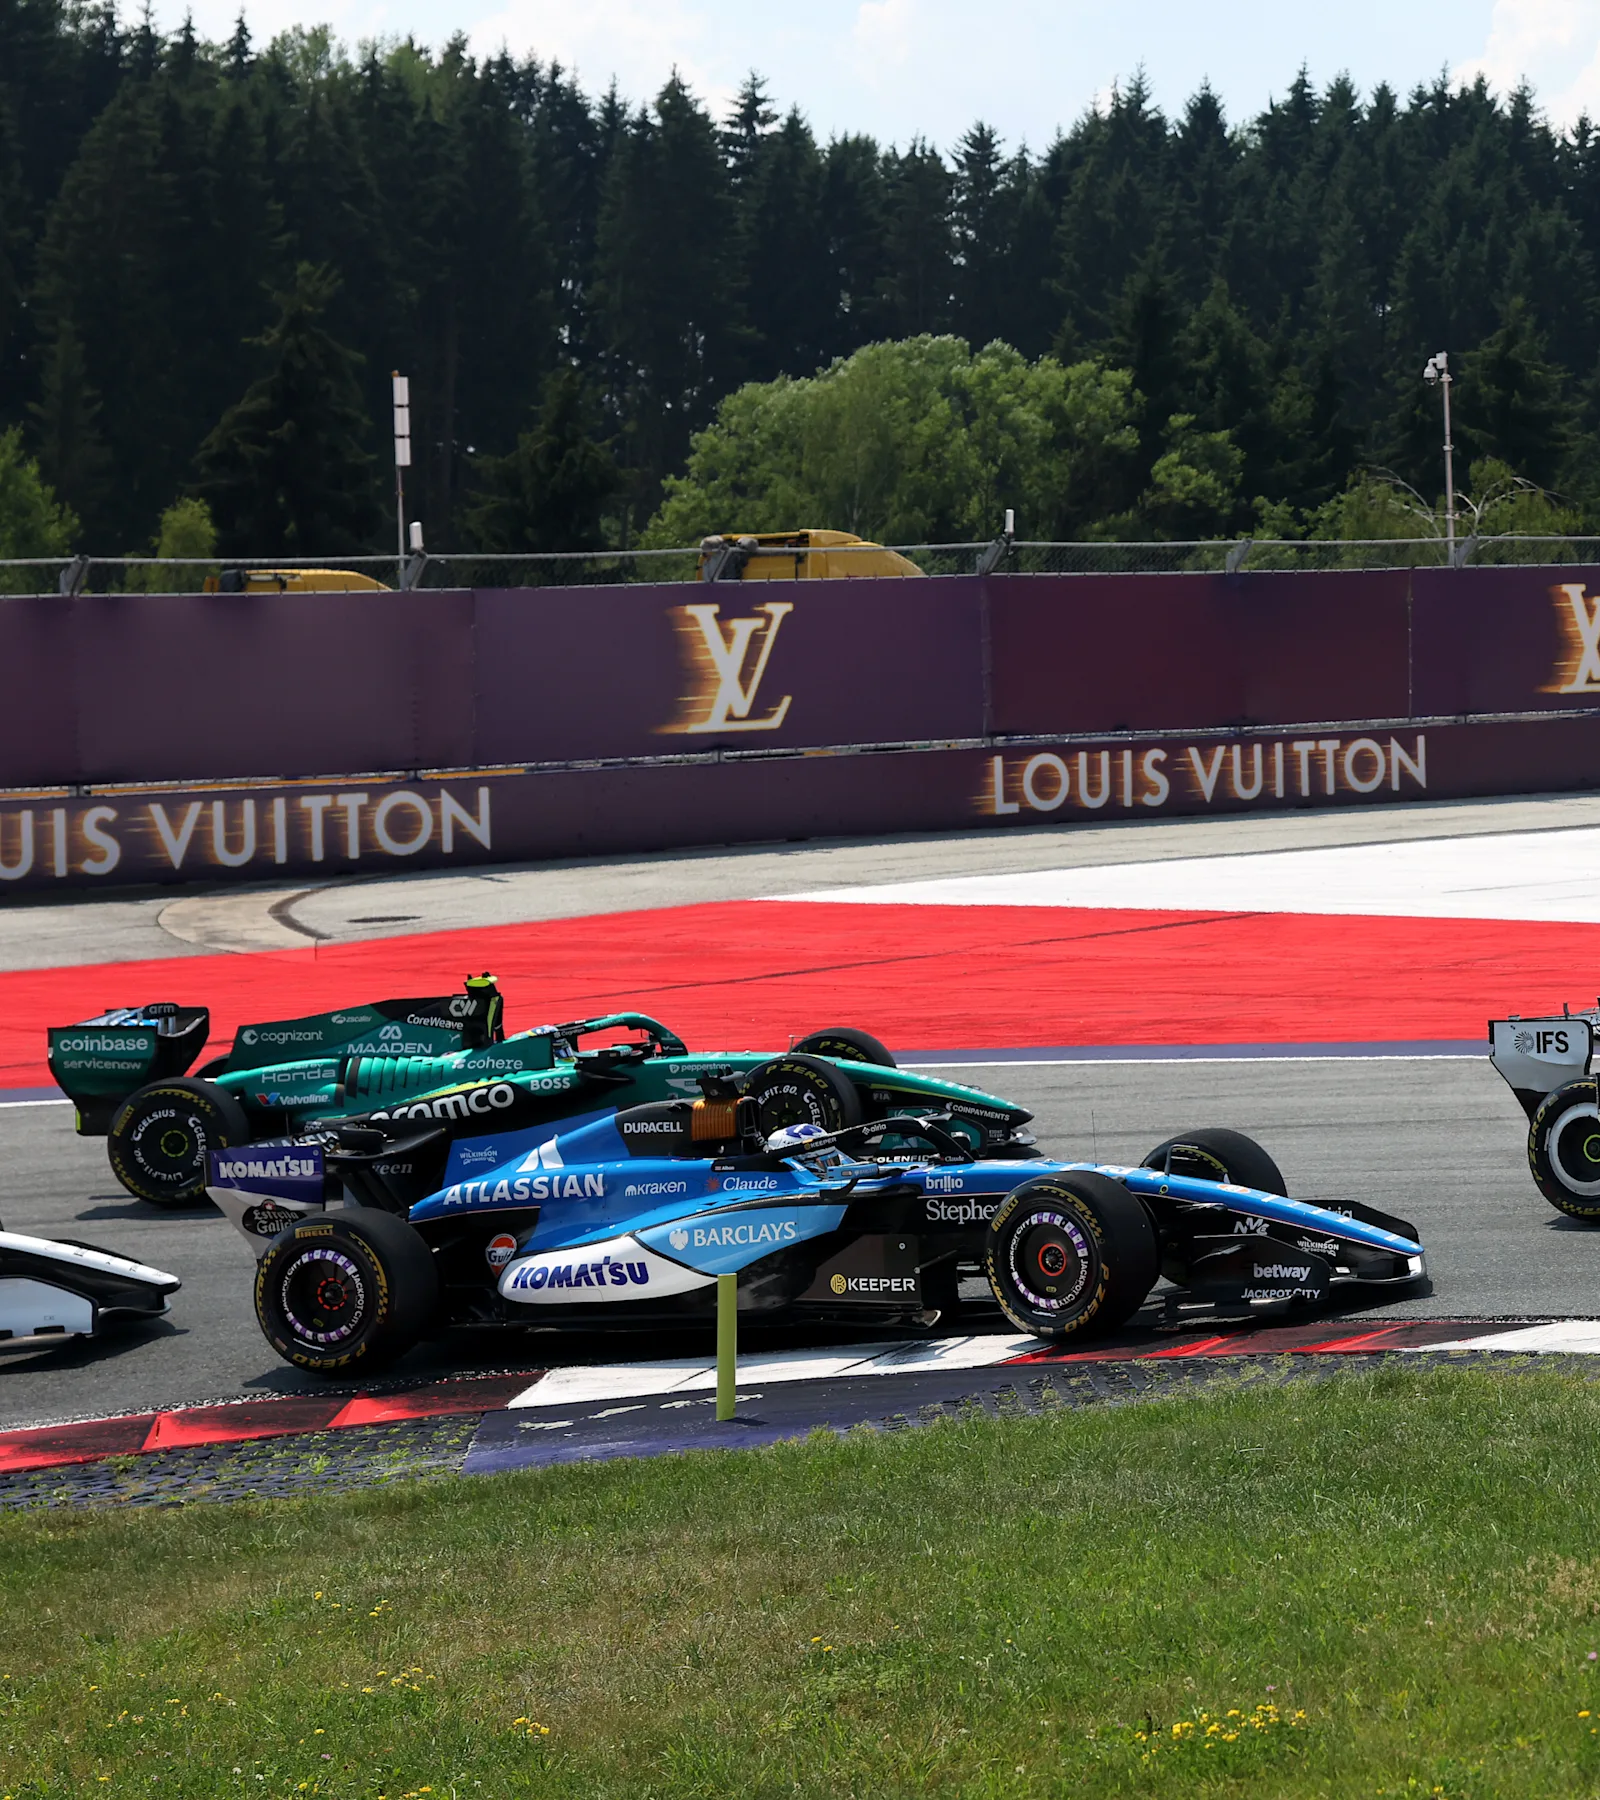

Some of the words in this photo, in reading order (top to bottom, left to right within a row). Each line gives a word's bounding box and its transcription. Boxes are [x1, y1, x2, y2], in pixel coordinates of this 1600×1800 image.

[993, 748, 1169, 814] LOUIS
[1188, 735, 1427, 803] VUITTON
[148, 786, 492, 870] VUITTON
[150, 1004, 175, 1014] arm
[407, 1014, 464, 1030] CoreWeave
[59, 1035, 148, 1051] coinbase
[260, 1030, 323, 1044] cognizant
[1536, 1031, 1569, 1054] IFS
[347, 1042, 433, 1054] MAADEN
[818, 1041, 831, 1049] P
[833, 1041, 867, 1061] ZER
[63, 1058, 142, 1070] servicenow
[467, 1056, 523, 1069] cohere
[262, 1069, 336, 1083] Honda
[766, 1064, 778, 1075] P
[780, 1062, 829, 1089] ZERO
[530, 1077, 571, 1091] BOSS
[280, 1093, 331, 1105] Valvoline
[872, 1092, 890, 1101] FIA
[952, 1103, 1010, 1121] COINPAYMENTS
[137, 1109, 176, 1133] CELSIUS
[623, 1121, 684, 1134] DURACELL
[870, 1123, 887, 1133] airia
[193, 1125, 207, 1167] CELSIUS
[810, 1137, 837, 1148] KEEPER
[459, 1149, 498, 1159] WILKINSON
[877, 1155, 930, 1163] GLENFID
[945, 1155, 964, 1163] Claude
[219, 1156, 315, 1178] KOMATSU
[443, 1173, 605, 1206] ATLASSIAN
[722, 1176, 778, 1191] Claude
[253, 1209, 300, 1221] Estrella
[926, 1198, 999, 1225] Stephe
[991, 1195, 1019, 1233] PIRELLI
[256, 1219, 292, 1235] Galici
[295, 1225, 334, 1239] PIRELLI
[694, 1221, 797, 1247] BARCLAYS
[1008, 1235, 1019, 1271] JACKPOT
[1015, 1218, 1032, 1235] CITY
[1297, 1240, 1340, 1251] WILKINSON
[487, 1249, 511, 1264] Gulf
[511, 1255, 650, 1289] KOMATSU
[1074, 1259, 1089, 1297] JACKPOT
[1101, 1262, 1110, 1281] P
[1253, 1263, 1311, 1281] betway
[281, 1274, 291, 1312] JACKPOT
[287, 1258, 302, 1277] CITY
[351, 1274, 365, 1311] JACKPOT
[848, 1278, 915, 1291] KEEPER
[1058, 1294, 1075, 1308] CITY
[1241, 1287, 1291, 1300] JACKPOT
[1294, 1287, 1320, 1300] CITY
[1065, 1283, 1106, 1333] ZERO
[349, 1311, 363, 1330] CITY
[355, 1341, 367, 1358] P
[291, 1352, 351, 1370] ZERO
